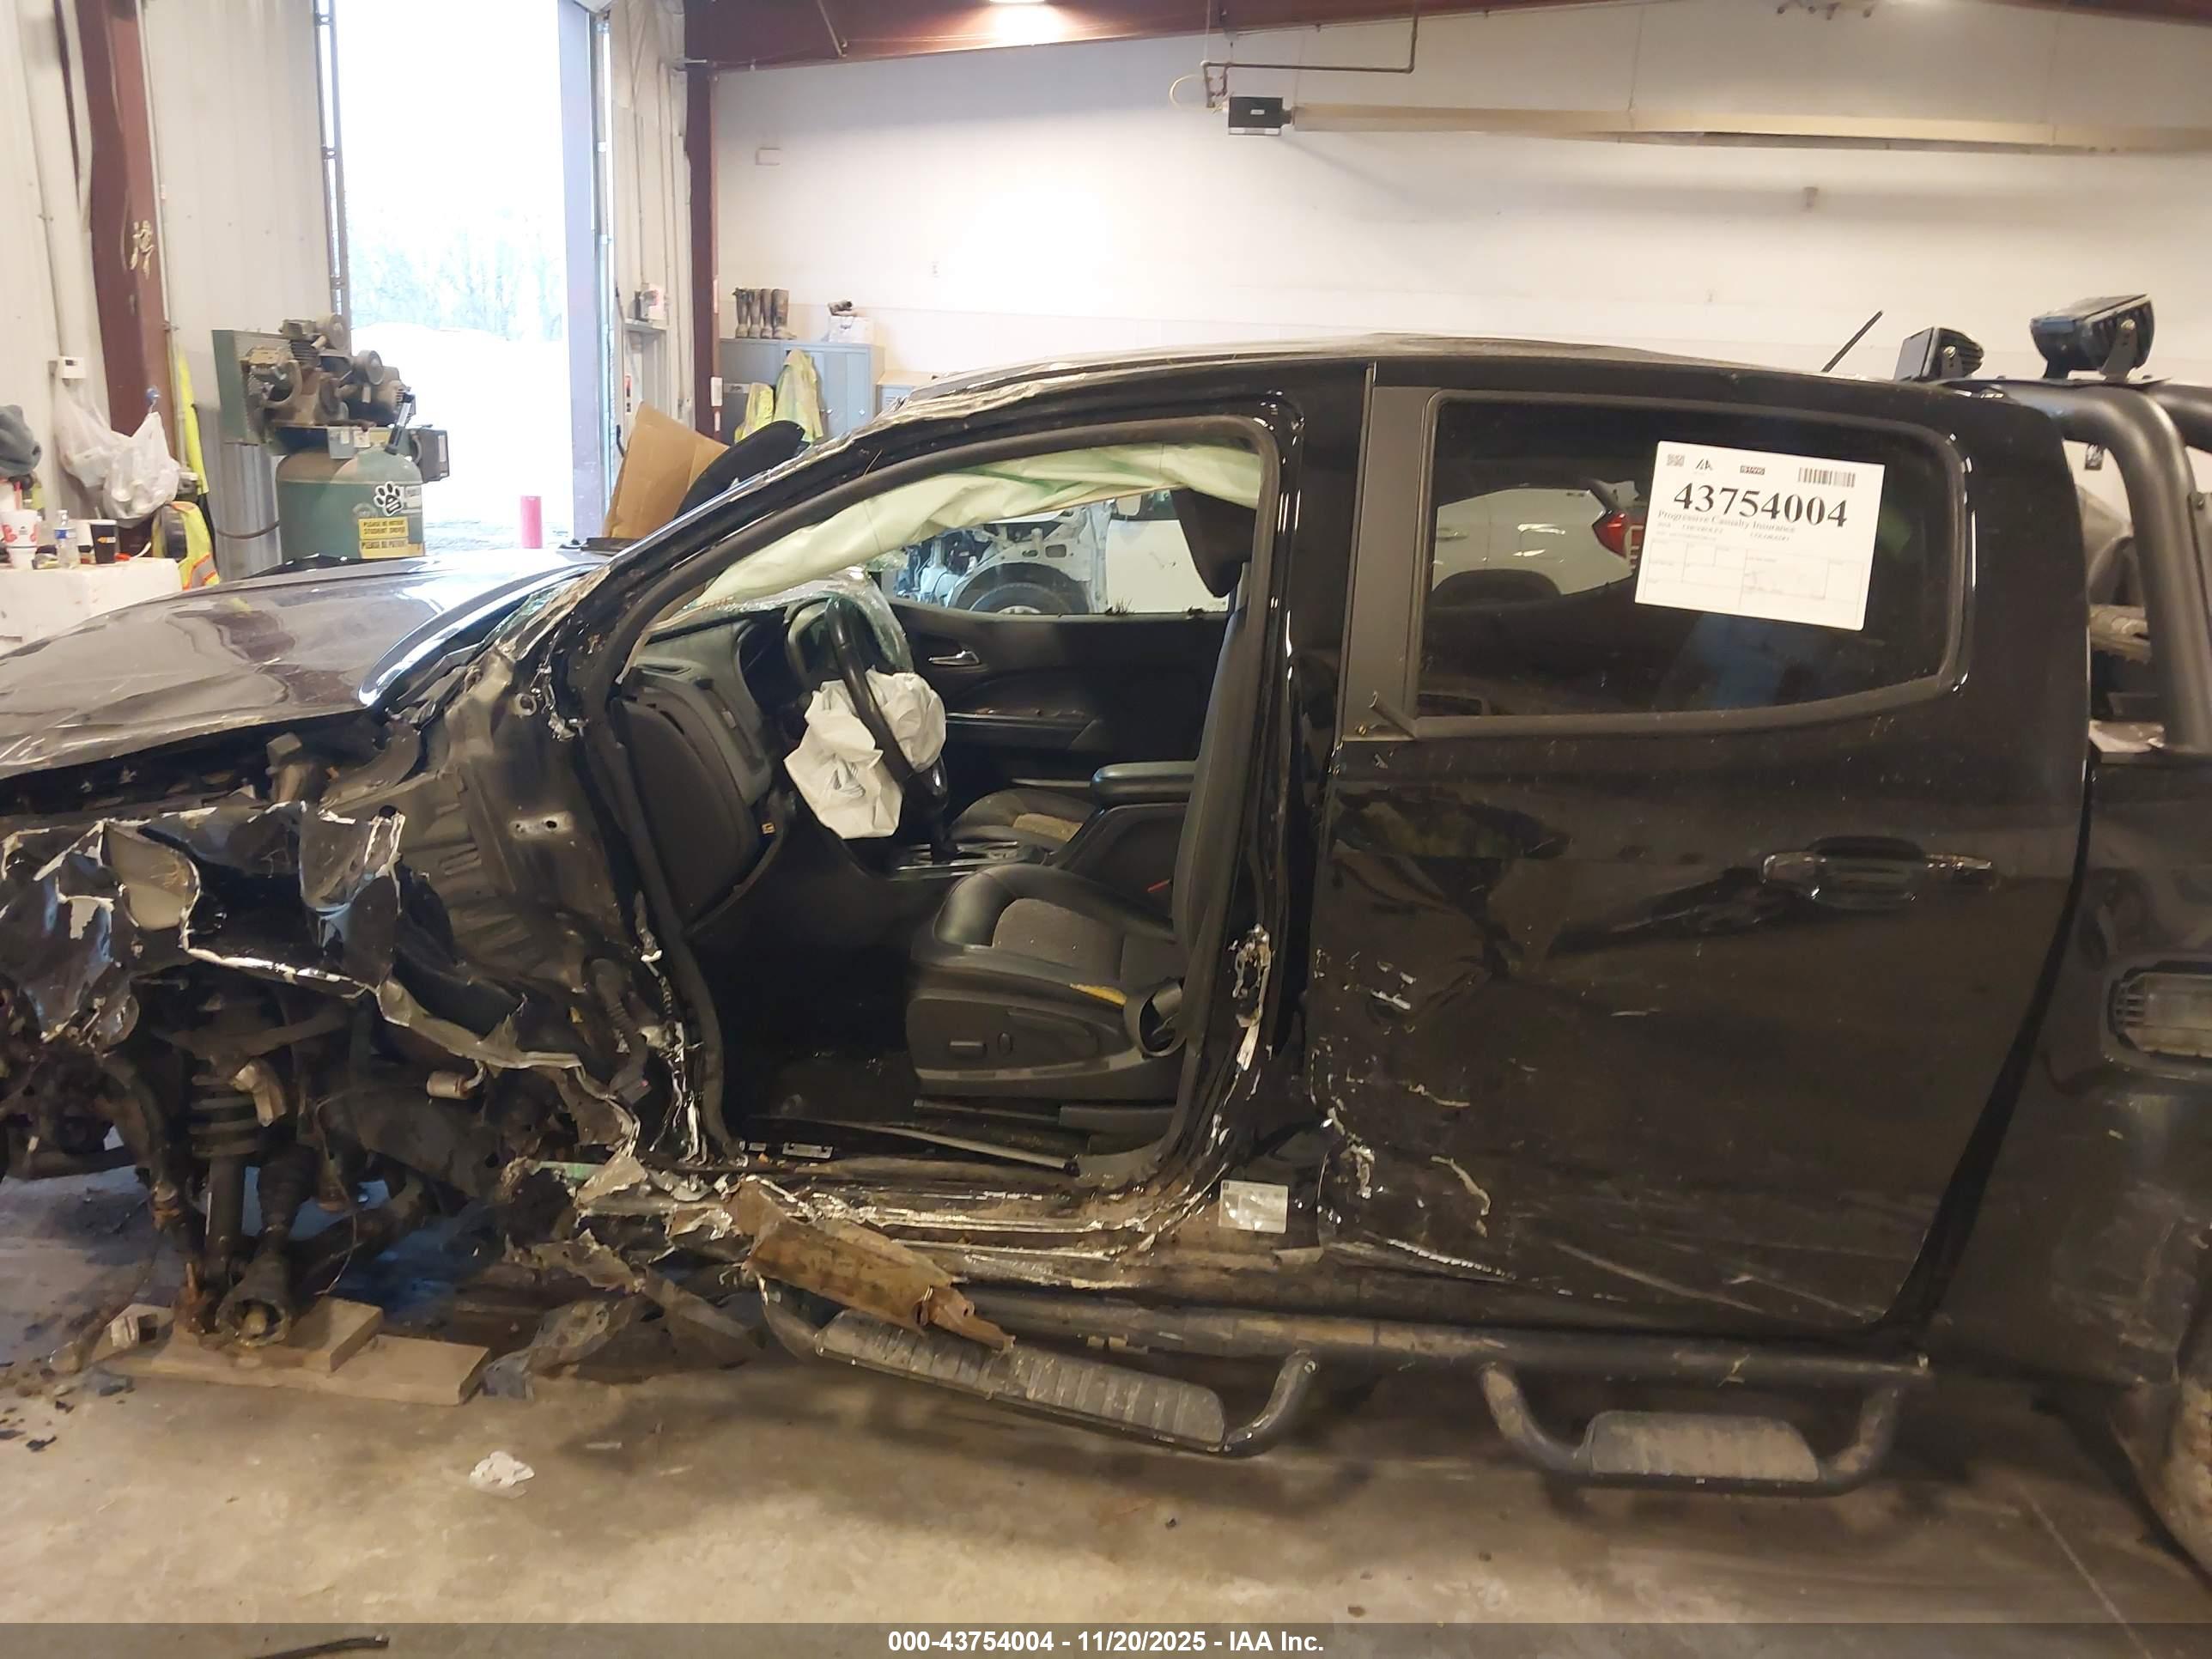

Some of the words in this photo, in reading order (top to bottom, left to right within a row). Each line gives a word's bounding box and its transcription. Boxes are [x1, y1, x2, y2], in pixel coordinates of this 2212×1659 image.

[1657, 509, 1711, 523] Progressive
[1711, 514, 1750, 529] Casualty
[1753, 520, 1796, 534] Insurance
[1674, 482, 1848, 528] 43754004
